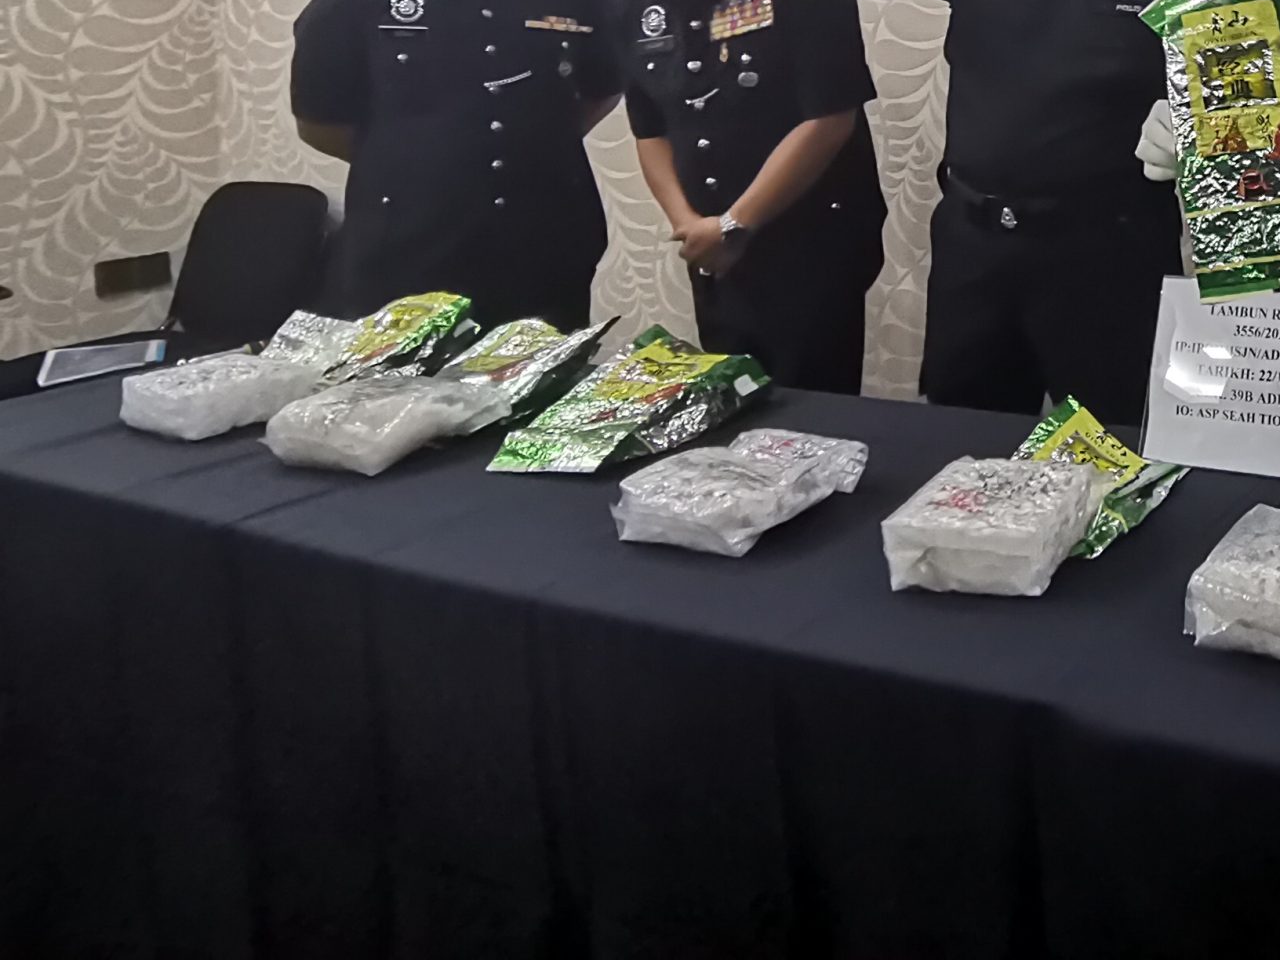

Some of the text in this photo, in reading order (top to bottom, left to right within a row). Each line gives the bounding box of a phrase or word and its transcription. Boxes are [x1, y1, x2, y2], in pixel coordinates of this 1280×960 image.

[1209, 304, 1268, 319] TAMBUN
[1198, 364, 1255, 381] TARIKH:
[1230, 389, 1254, 403] 39B
[1175, 404, 1194, 417] IO:
[1196, 407, 1220, 420] ASP
[1222, 410, 1256, 424] SEAH
